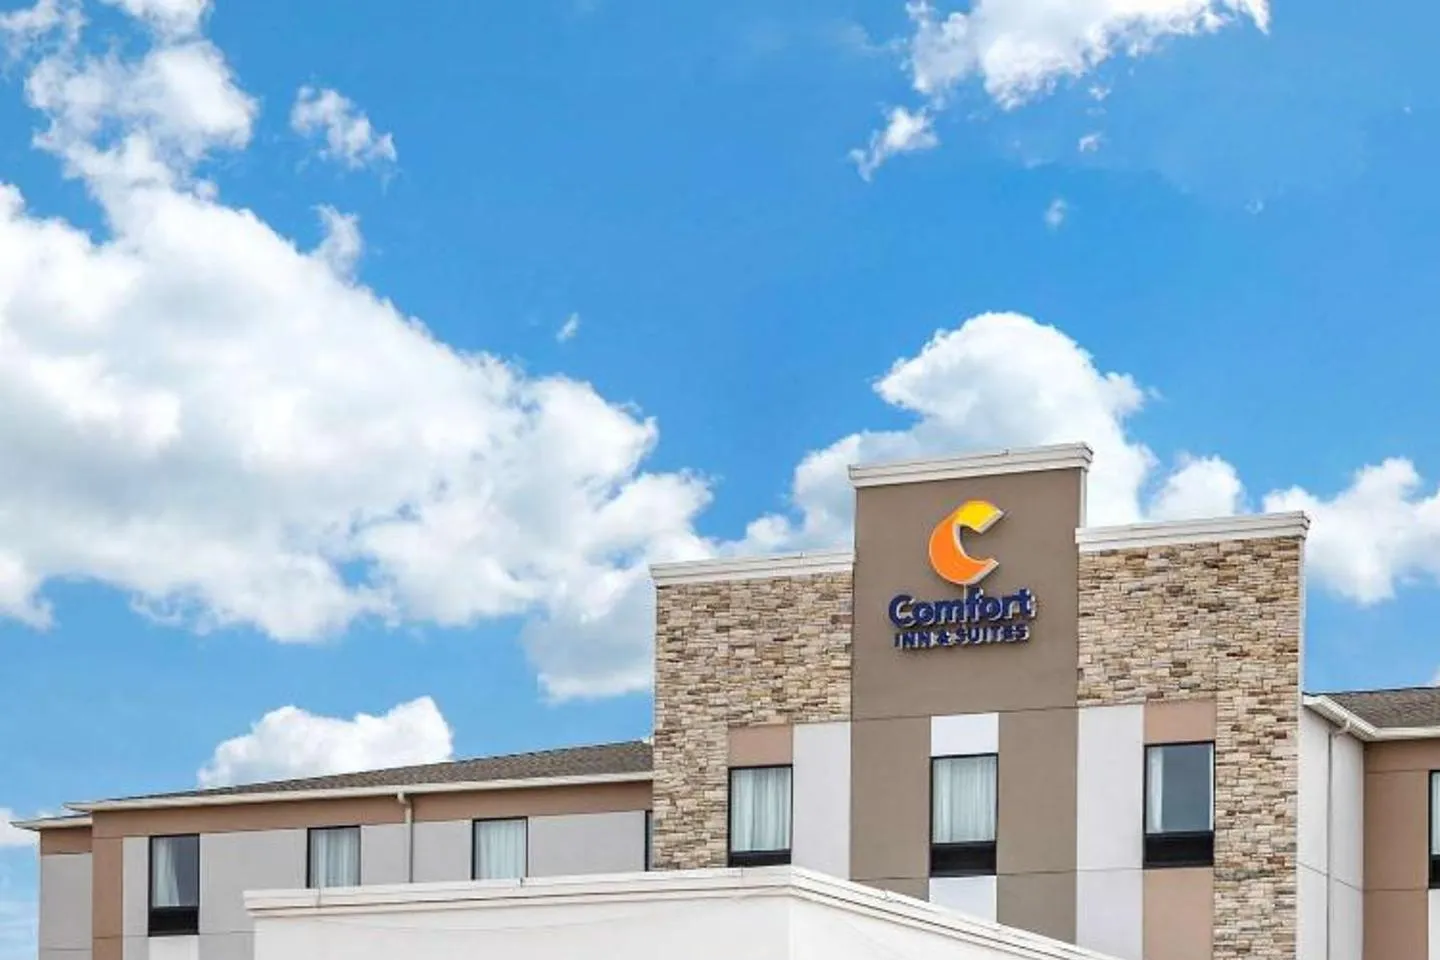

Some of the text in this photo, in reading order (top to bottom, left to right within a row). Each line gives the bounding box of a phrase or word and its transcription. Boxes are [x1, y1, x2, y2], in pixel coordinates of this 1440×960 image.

[889, 587, 1036, 628] Comfort
[894, 630, 936, 649] INN
[955, 623, 1030, 645] SUITES
